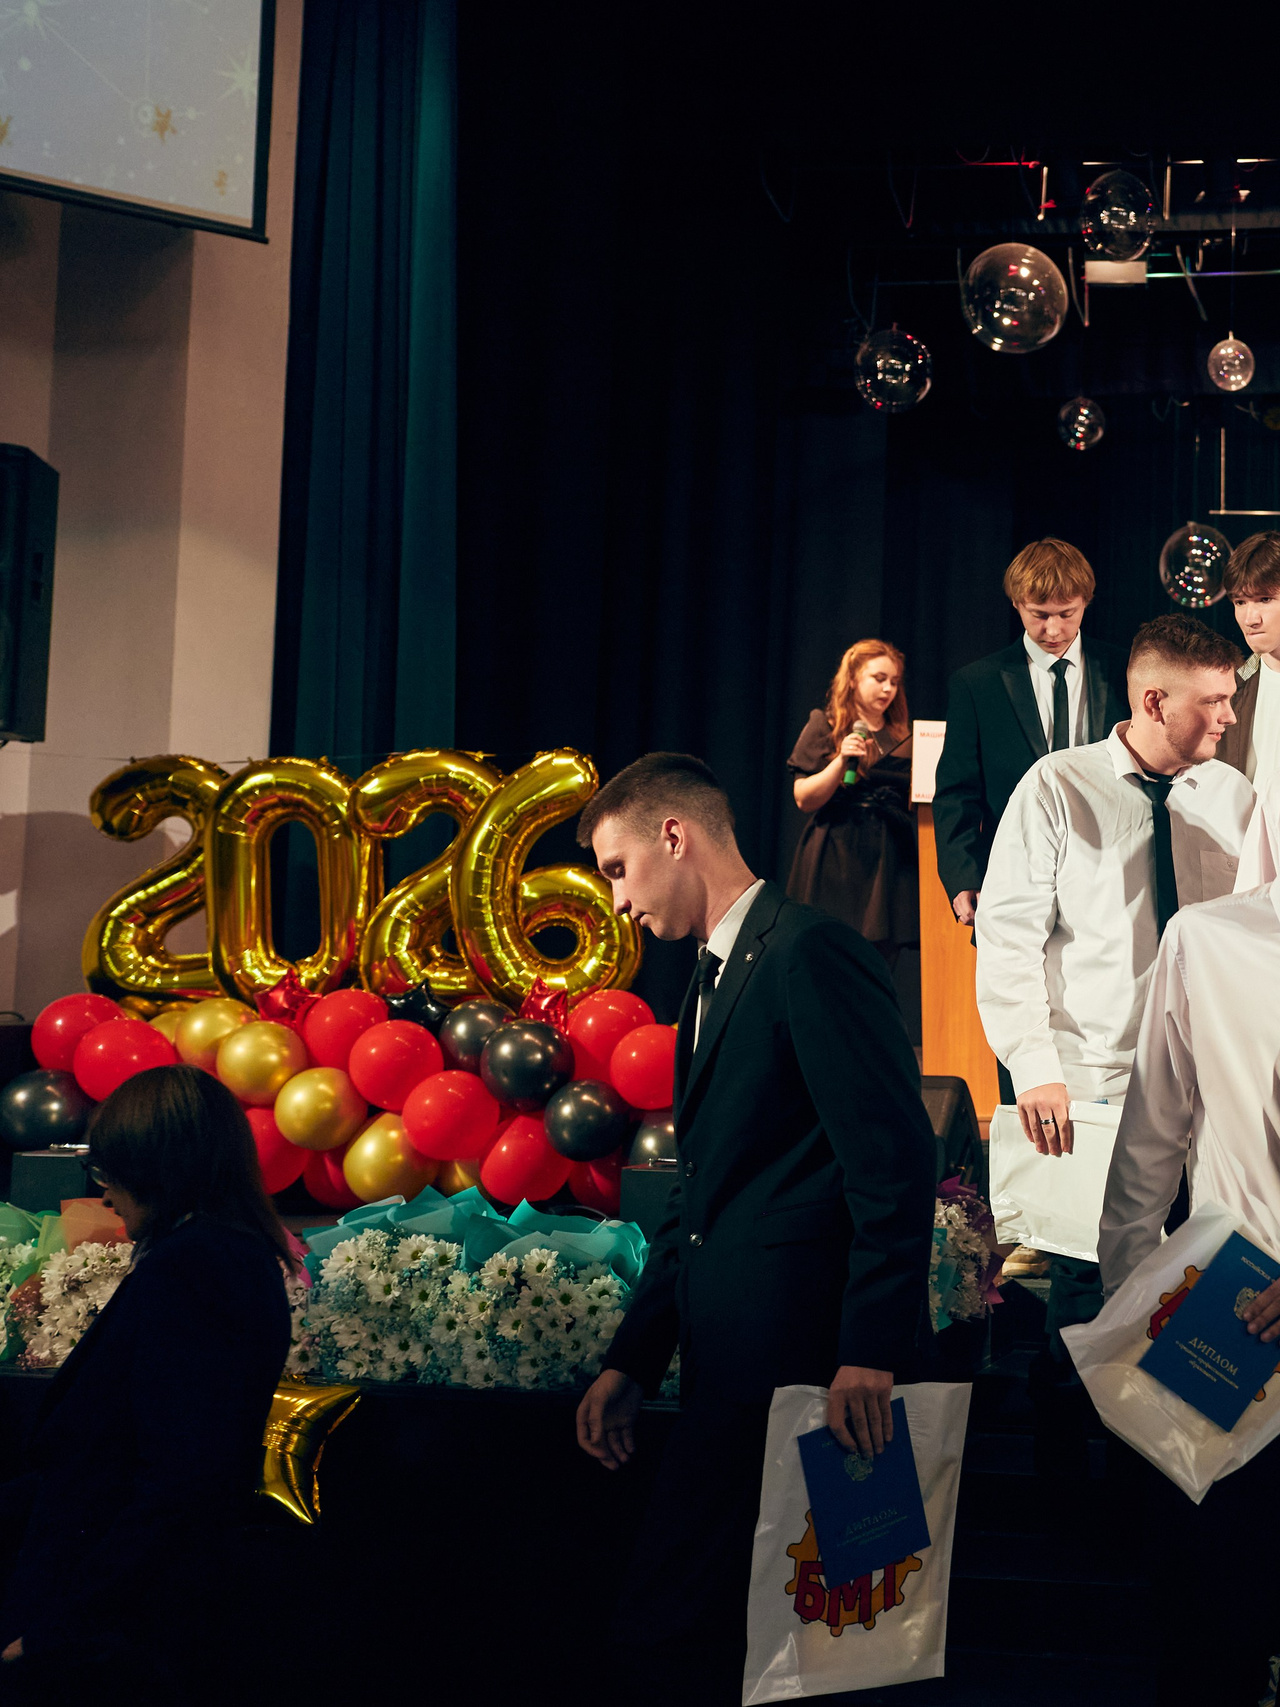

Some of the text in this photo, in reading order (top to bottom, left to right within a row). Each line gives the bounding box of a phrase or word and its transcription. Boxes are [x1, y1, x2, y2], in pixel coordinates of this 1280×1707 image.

[82, 747, 643, 1002] 2026
[1189, 1337, 1239, 1375] ДИПЛОМ
[845, 1509, 898, 1536] ДИПЛОМ
